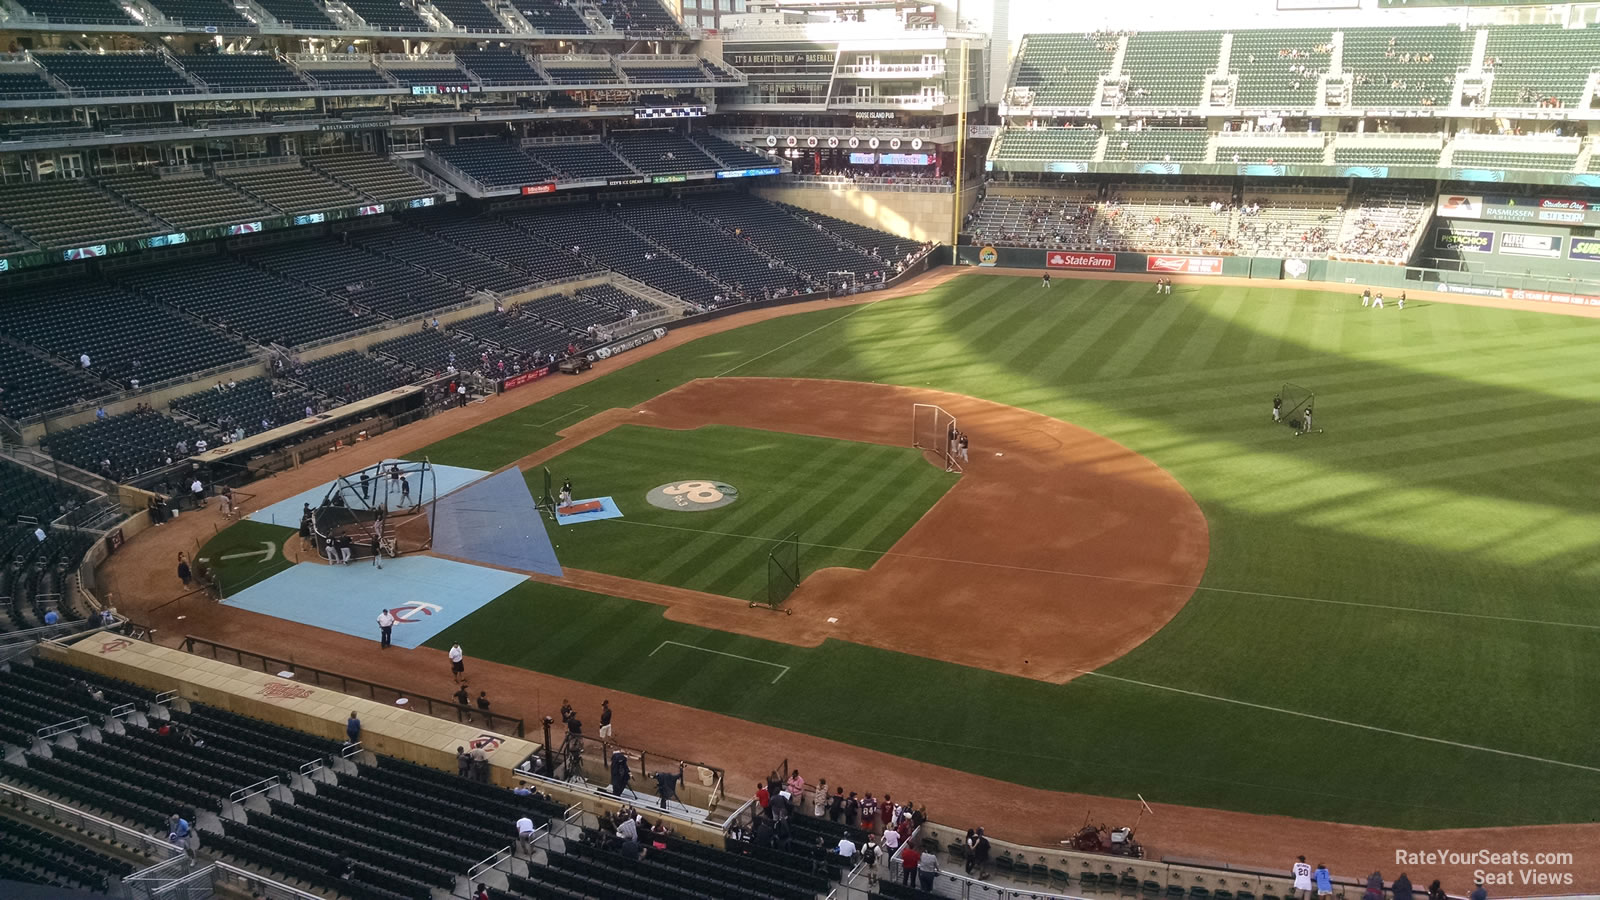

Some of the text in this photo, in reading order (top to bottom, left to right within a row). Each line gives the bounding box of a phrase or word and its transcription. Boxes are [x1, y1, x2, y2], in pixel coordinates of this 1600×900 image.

[735, 55, 746, 63] IT'S
[753, 55, 783, 63] BEAUTIFUL
[806, 54, 833, 62] BASEBALL
[776, 84, 796, 93] TWINS
[1542, 200, 1569, 208] Student
[1486, 208, 1534, 217] RASMUSSEN
[1442, 234, 1488, 246] PISTACHIOS
[1298, 868, 1308, 876] 20
